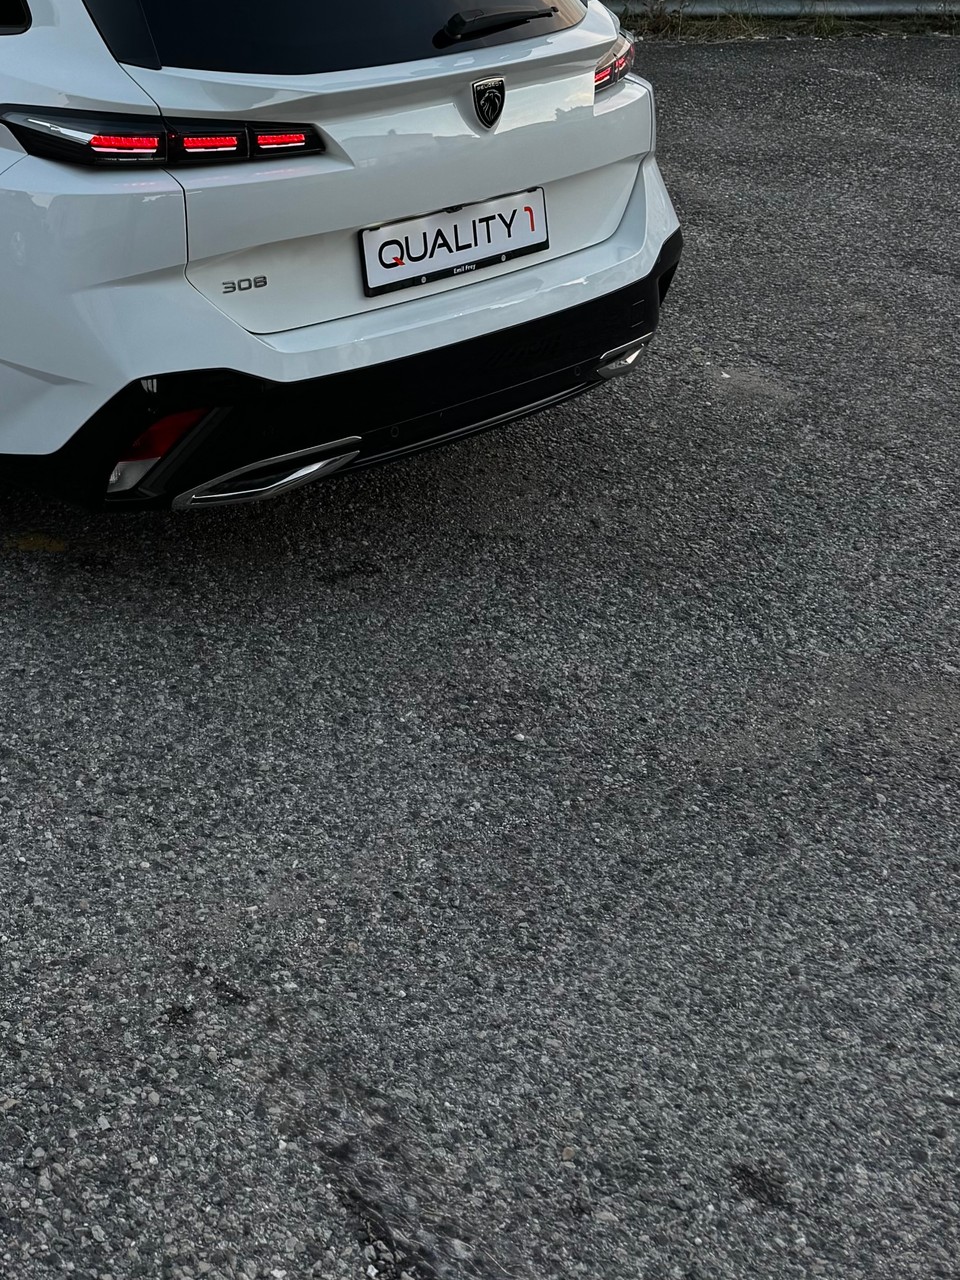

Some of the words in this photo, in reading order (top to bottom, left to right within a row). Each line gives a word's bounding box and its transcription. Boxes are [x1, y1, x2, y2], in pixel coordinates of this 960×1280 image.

[377, 208, 518, 269] QUALITY
[523, 206, 536, 232] 1
[221, 275, 268, 294] 308
